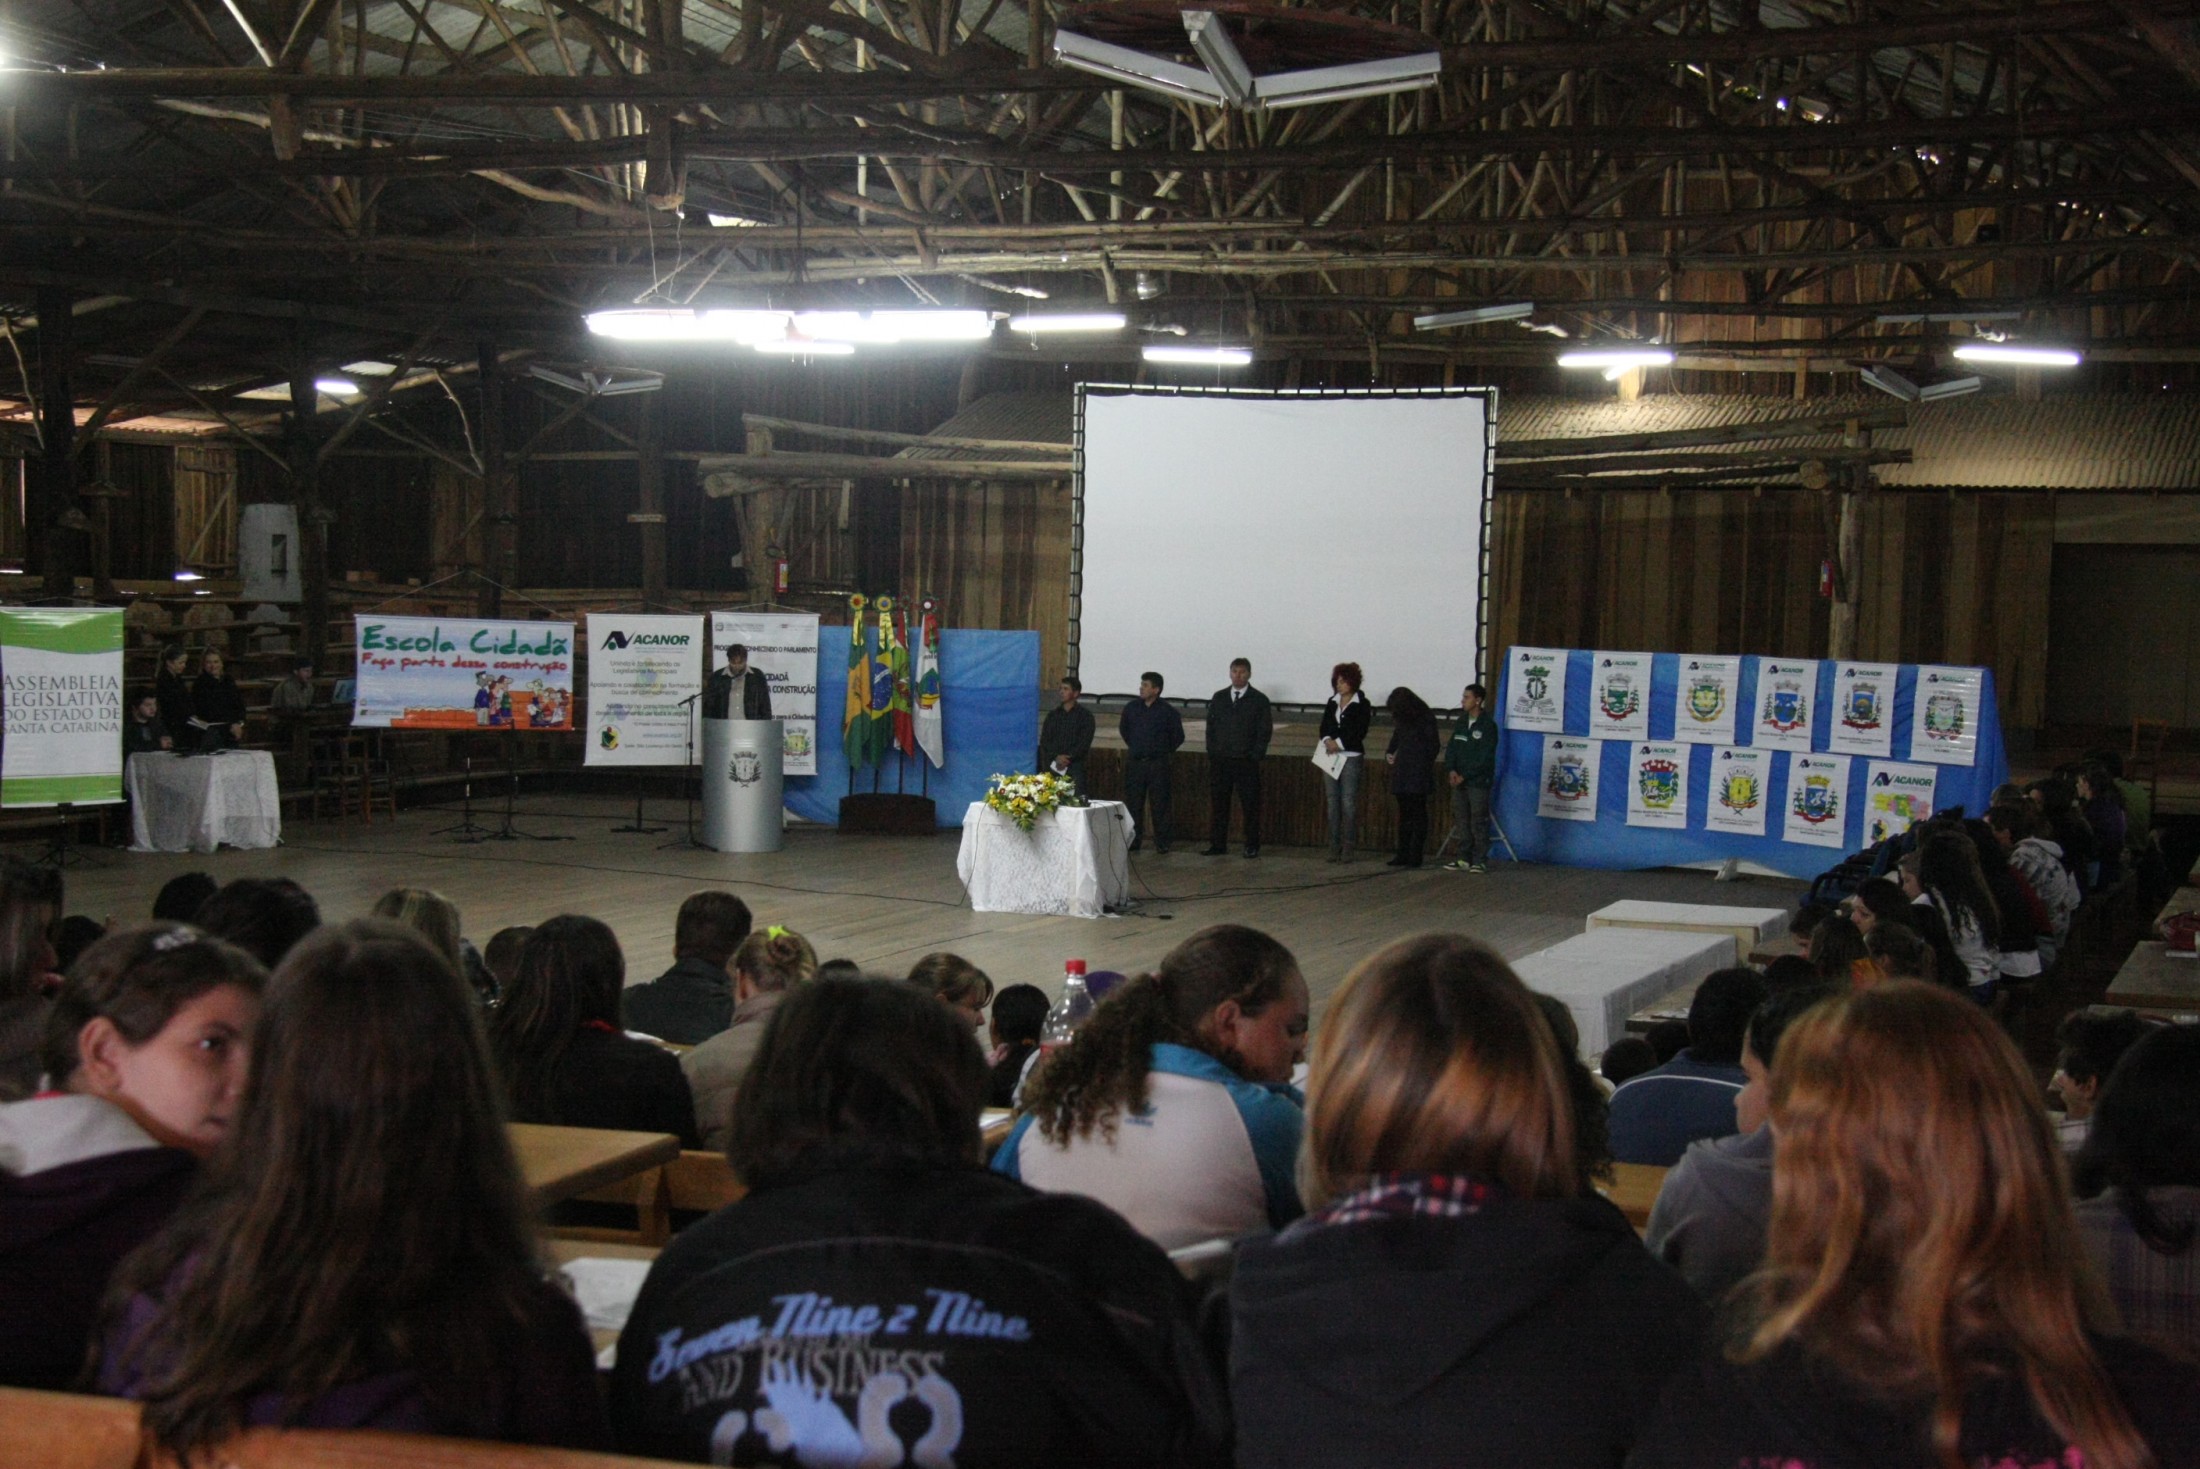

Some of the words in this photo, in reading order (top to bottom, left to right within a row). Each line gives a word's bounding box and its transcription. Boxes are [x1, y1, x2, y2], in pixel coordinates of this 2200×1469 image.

[362, 624, 455, 653] Escola
[470, 628, 568, 655] Cidadã
[633, 635, 690, 646] ACANOR
[784, 646, 817, 654] PARLAMENTO
[361, 652, 395, 670] Faça
[401, 656, 446, 671] parte
[493, 658, 568, 674] construção
[4, 674, 119, 691] ASSEMBLEIA
[772, 684, 816, 696] CONSTRUÇÃO
[34, 708, 94, 720] ESTADO
[100, 707, 120, 719] DE
[51, 722, 119, 733] CATARINA
[1894, 776, 1933, 787] ACANOR
[772, 1290, 885, 1338] Nine
[924, 1287, 1032, 1341] Nine
